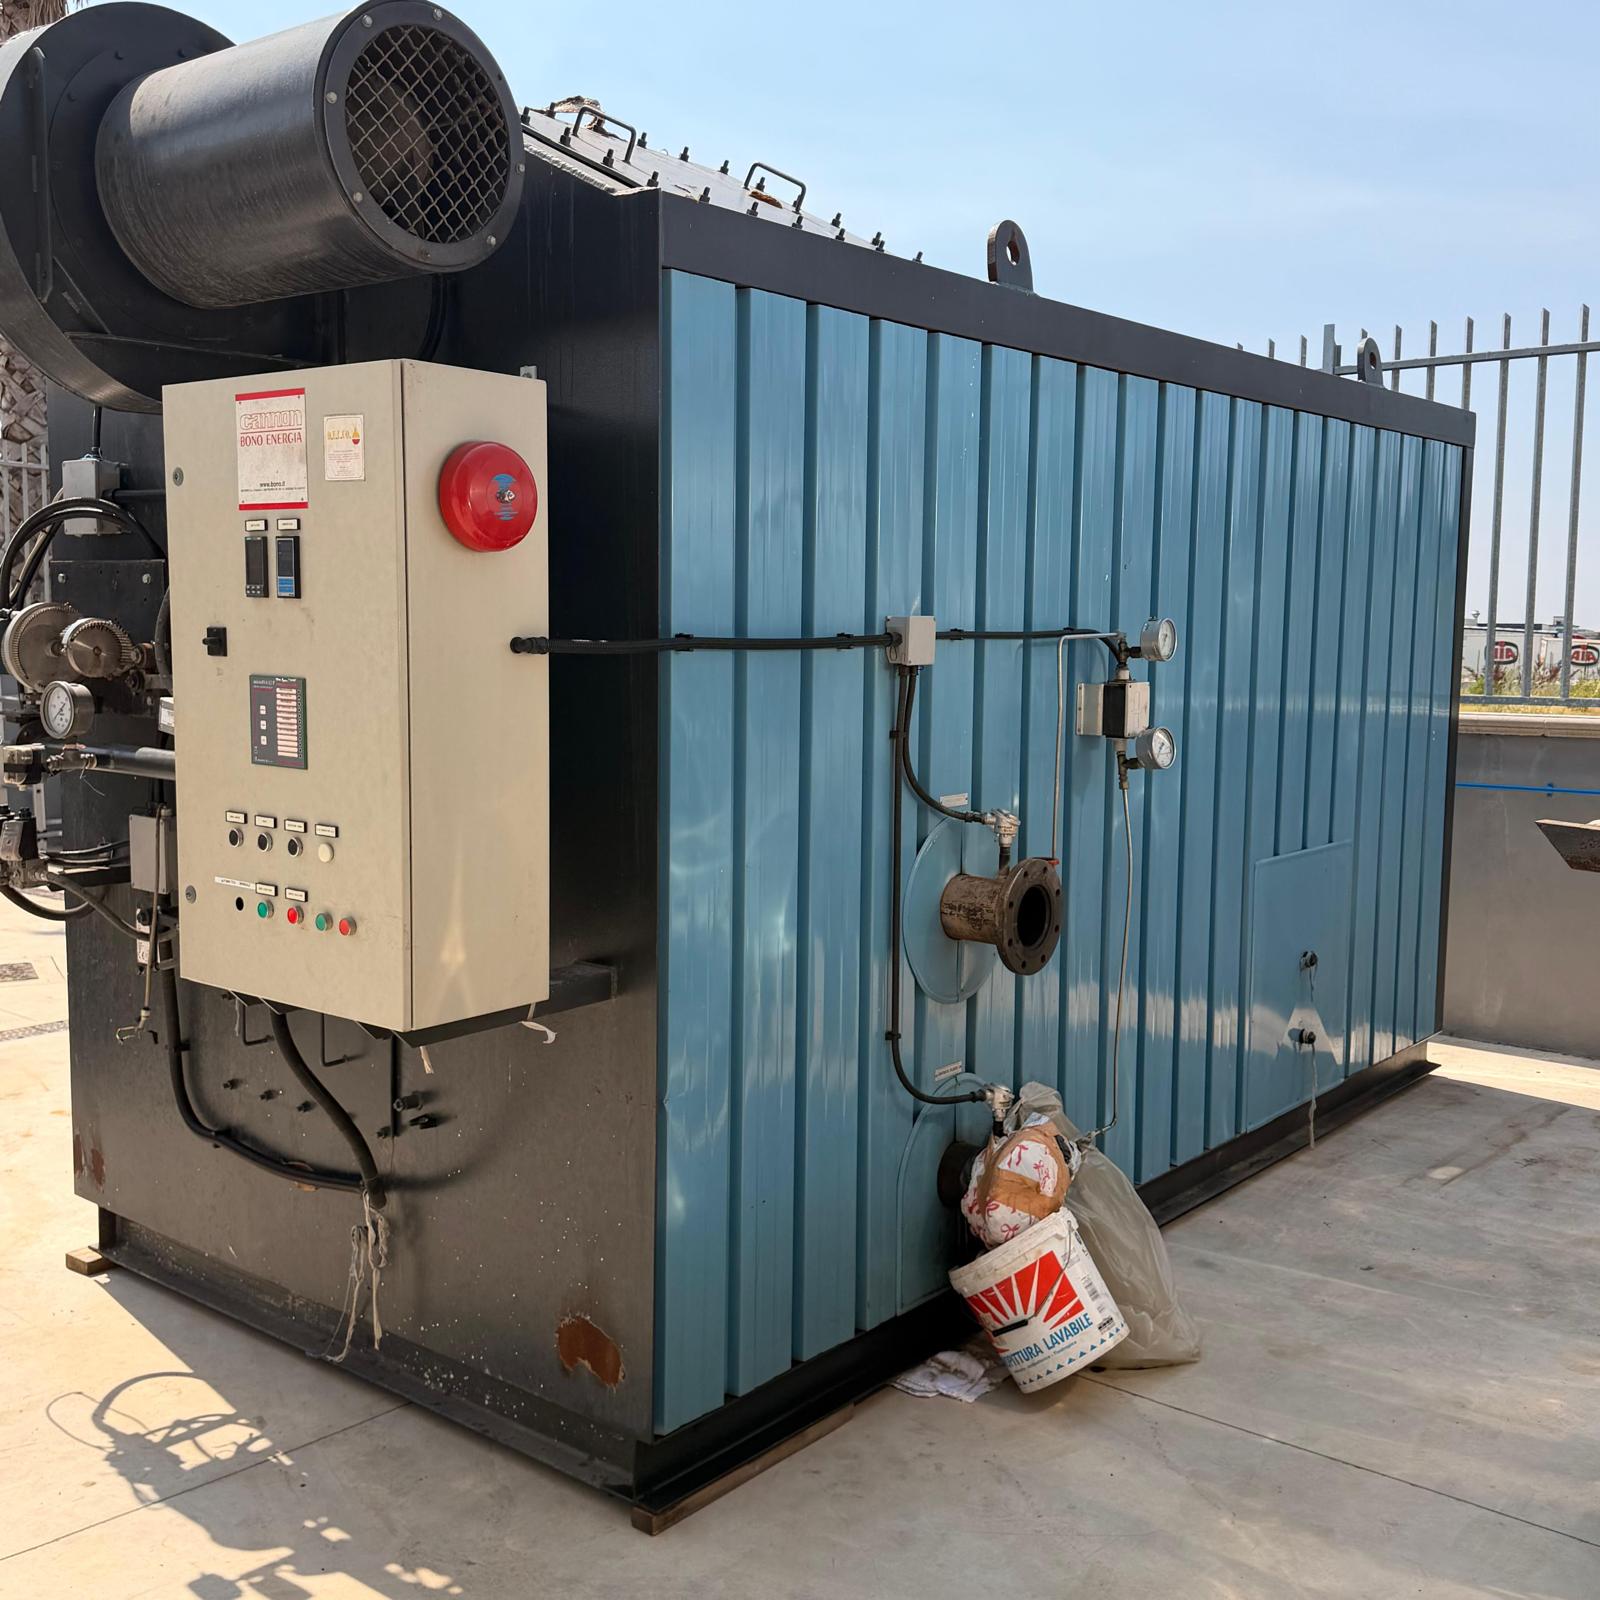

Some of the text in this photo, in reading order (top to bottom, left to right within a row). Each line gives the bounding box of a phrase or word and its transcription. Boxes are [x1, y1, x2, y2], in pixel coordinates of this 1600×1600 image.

[240, 409, 302, 430] cannon
[240, 431, 302, 447] BONO ENERGIA
[1042, 1312, 1094, 1351] LAVABILE
